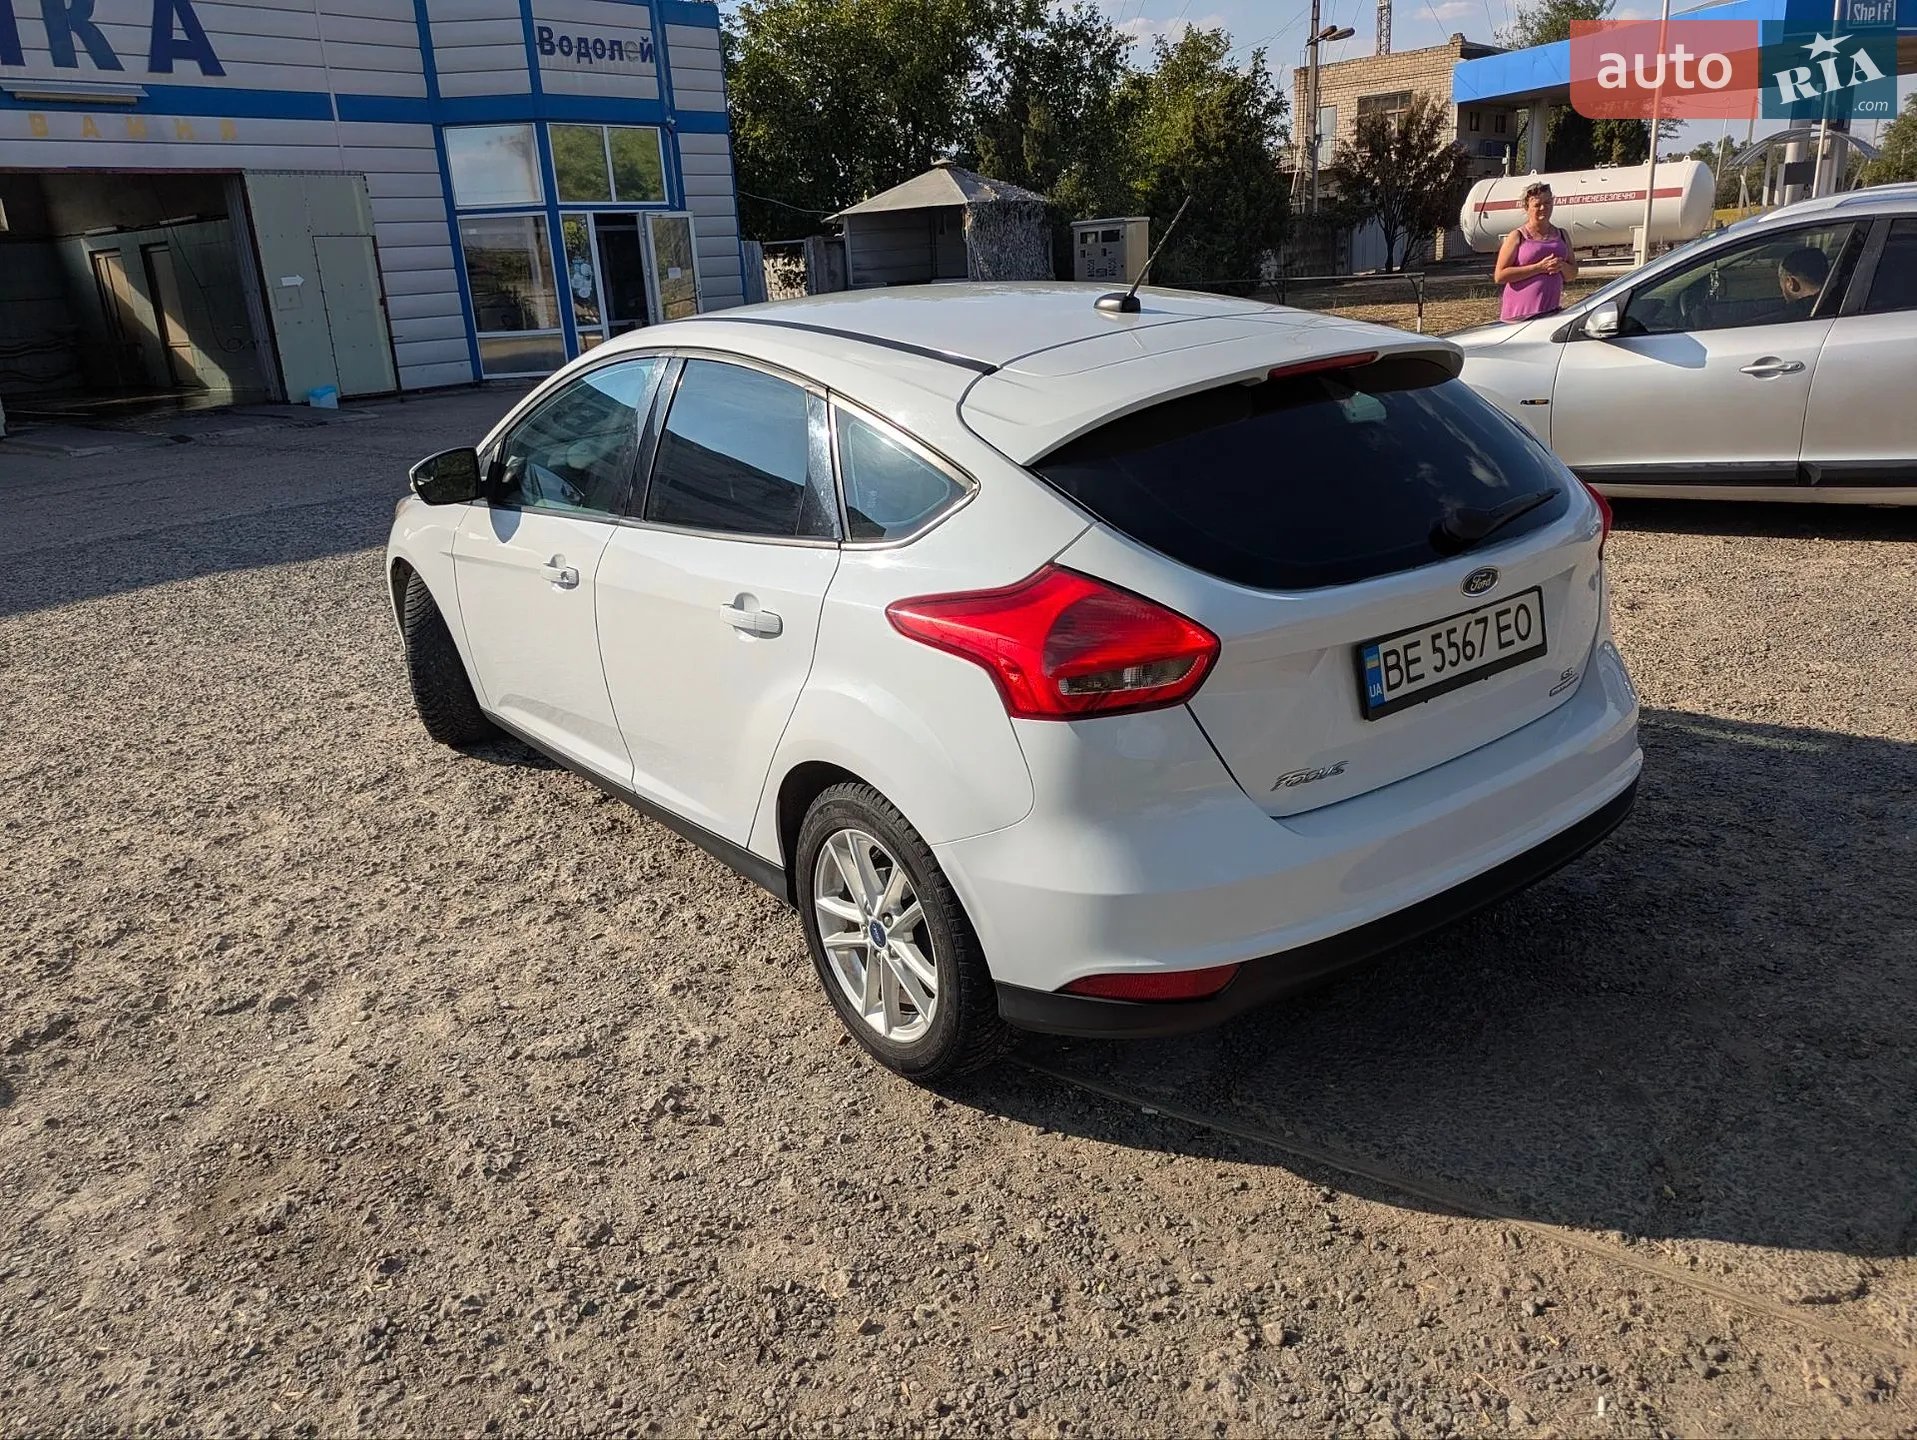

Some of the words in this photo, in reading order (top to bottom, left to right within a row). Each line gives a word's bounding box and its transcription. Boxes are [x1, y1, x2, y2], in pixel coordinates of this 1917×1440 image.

[1852, 3, 1891, 25] Shelf
[536, 25, 654, 64] Водолей
[1471, 573, 1493, 592] Ford
[1382, 640, 1425, 692] BE
[1431, 615, 1489, 674] 5567
[1495, 603, 1532, 650] EO
[1369, 684, 1383, 698] UA
